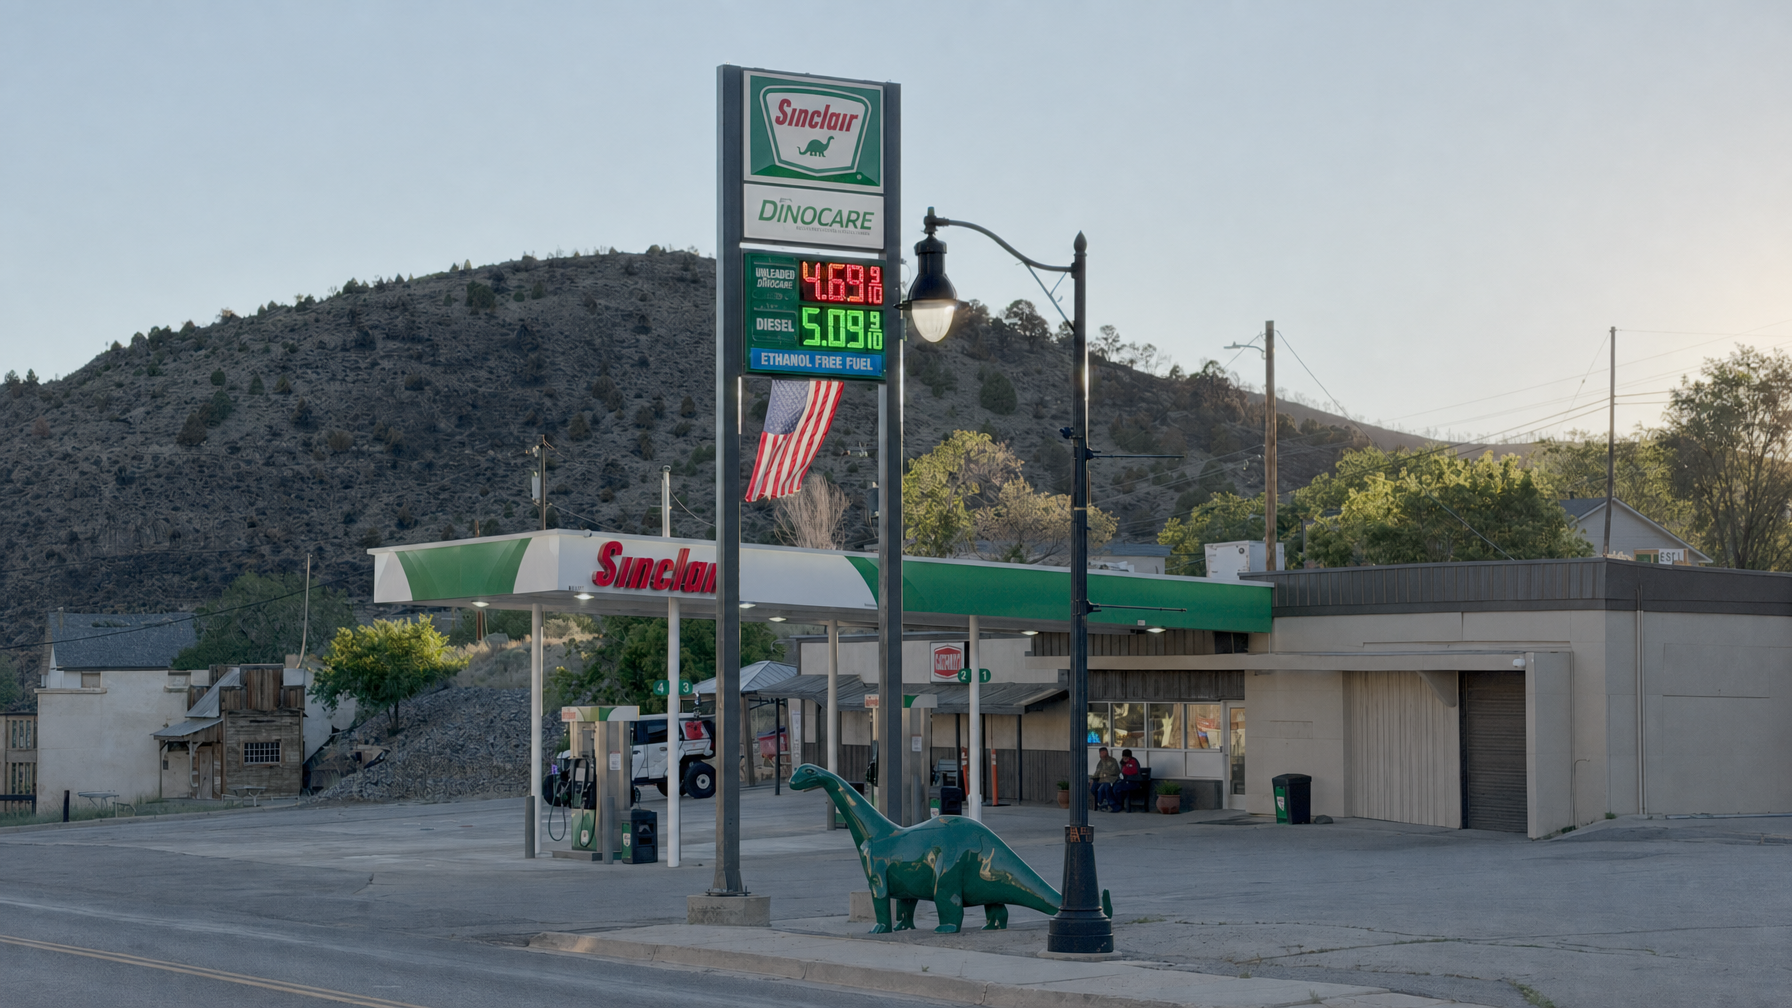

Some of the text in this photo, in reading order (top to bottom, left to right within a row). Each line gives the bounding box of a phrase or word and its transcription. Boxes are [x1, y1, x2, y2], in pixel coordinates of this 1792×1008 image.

[775, 98, 858, 132] Sinclair
[755, 267, 795, 280] UNLEADED
[802, 261, 864, 303] 4.69
[756, 317, 795, 333] DIESEL
[802, 306, 864, 349] 5.09
[761, 352, 873, 371] ETHANOL FREE FUEL
[592, 540, 717, 594] Sinclai
[960, 670, 967, 680] 2
[981, 670, 987, 681] 1
[657, 682, 664, 694] 4
[682, 682, 690, 693] 3
